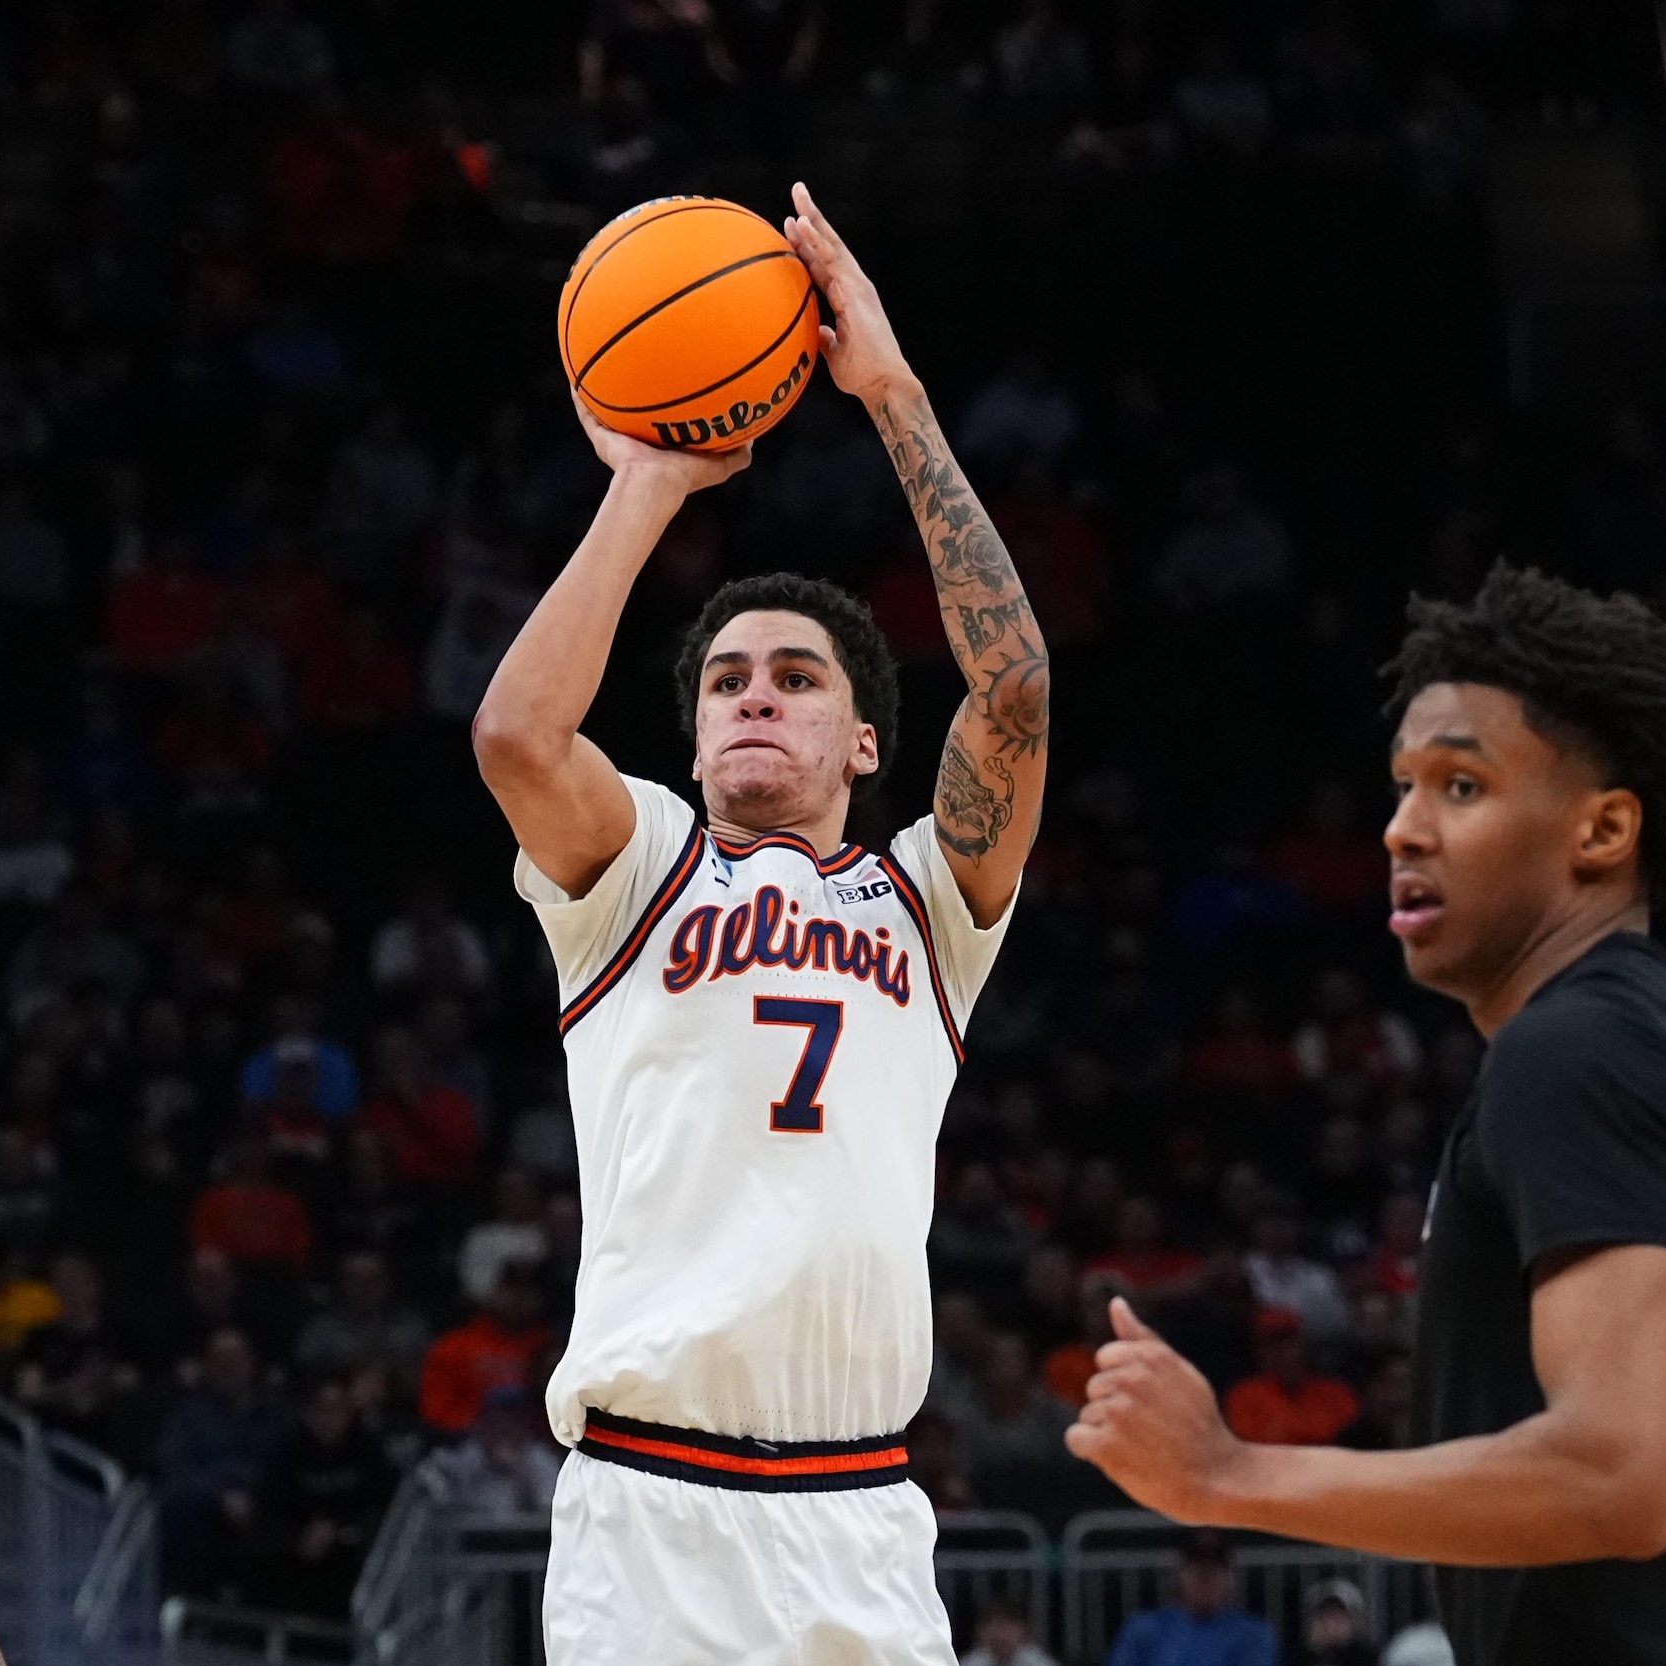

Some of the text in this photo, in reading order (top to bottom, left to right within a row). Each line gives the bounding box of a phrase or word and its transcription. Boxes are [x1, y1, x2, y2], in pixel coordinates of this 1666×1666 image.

[651, 350, 811, 446] Wilson
[662, 885, 912, 1008] Illinois
[753, 995, 844, 1133] 7
